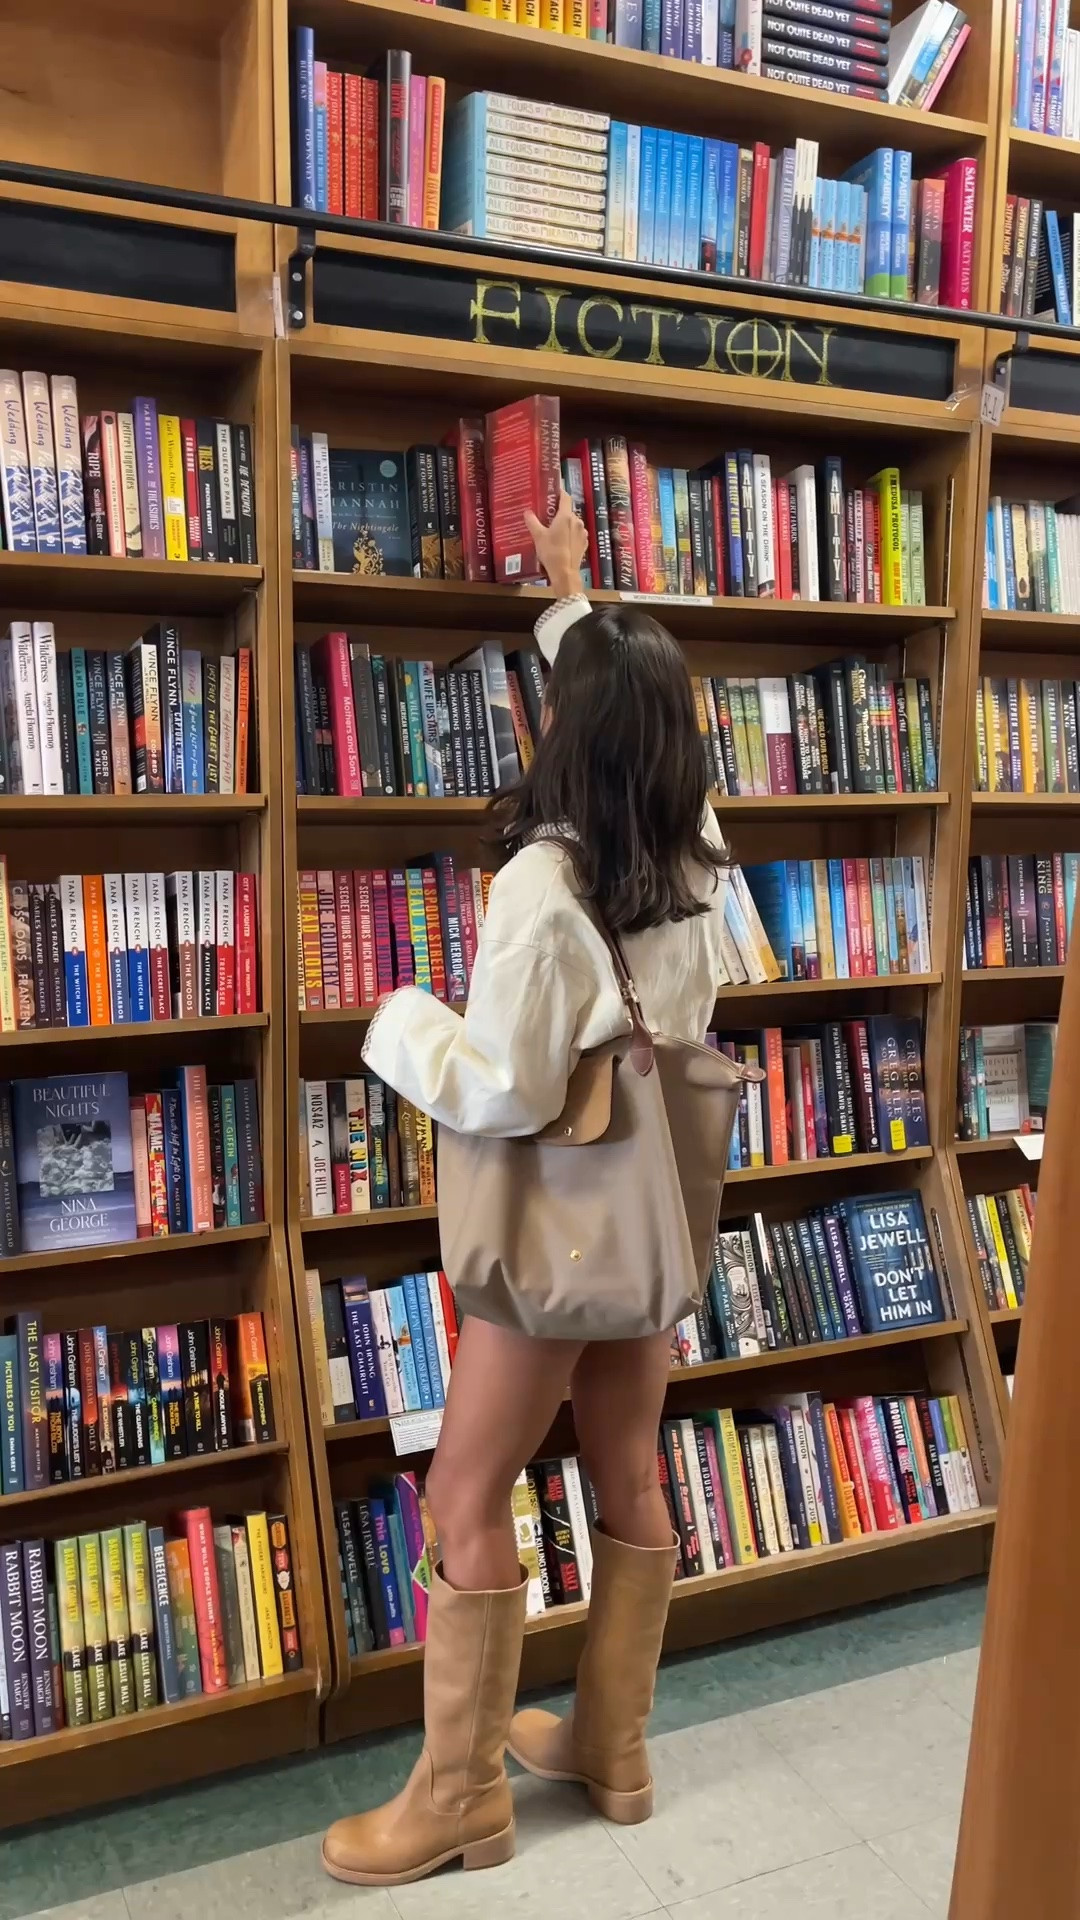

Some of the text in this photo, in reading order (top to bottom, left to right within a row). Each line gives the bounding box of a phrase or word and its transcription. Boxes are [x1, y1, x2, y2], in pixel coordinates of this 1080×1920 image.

[767, 20, 850, 48] NOT QUITE DEAD YET
[767, 69, 850, 94] NOT QUITE DEAD YET
[881, 152, 892, 219] CULPABILITY
[897, 154, 909, 220] CULPABILITY
[961, 166, 976, 293] SALTWATER KATY HAYS
[1032, 203, 1040, 236] STEPHEN
[469, 279, 838, 386] FICTION
[5, 400, 20, 444] Wedding
[33, 401, 49, 446] Wedding
[62, 404, 76, 448] Wedding
[143, 403, 152, 440] HARRIET
[982, 392, 997, 421] K-L
[88, 452, 100, 477] RIPE
[466, 440, 477, 486] HANNAH
[550, 423, 560, 470] KRISTIN
[591, 451, 601, 491] HARKAWAY
[333, 521, 399, 532] The Nightingale
[475, 507, 488, 555] WOMEN
[743, 463, 753, 577] AMITY
[830, 470, 841, 581] AMITY
[618, 543, 631, 586] HARKIN
[40, 634, 51, 682] Wilderness
[166, 629, 177, 706] VINCE FLYNN
[94, 656, 104, 725] VINCE FLYNN
[150, 683, 158, 721] FLYNN
[531, 667, 542, 697] QUEEN
[343, 697, 352, 726] Mothers
[348, 751, 356, 776] Sons
[429, 705, 437, 743] UPSTAIRS
[301, 893, 322, 987] DEAD LIONS
[318, 889, 339, 986] JOE COUNTRY
[339, 886, 354, 993] SECRET HOURS MICK HERRON
[424, 889, 445, 979] SPOOK STREET
[447, 917, 464, 976] MICK HERRON
[18, 973, 31, 1026] FRANZEN
[33, 1083, 111, 1103] BEAUTIFUL
[907, 1039, 922, 1123] GREG ILES
[46, 1102, 99, 1118] NIGHTS
[225, 1098, 234, 1157] EMILY GIFFIN
[311, 1094, 326, 1197] NOS4A2 JOE HILL
[348, 1107, 368, 1183] THE NIX
[50, 1213, 109, 1232] GEORGE
[61, 1198, 97, 1213] NINA
[869, 1211, 909, 1228] LISA
[743, 1240, 754, 1273] REUNION
[777, 1246, 787, 1268] JEWELL
[831, 1227, 846, 1283] LISA JEWELL
[860, 1230, 926, 1250] JEWELL
[714, 1244, 724, 1284] TWILIGHT
[875, 1265, 925, 1287] DON'T
[880, 1301, 932, 1321] HIM IN
[889, 1286, 916, 1301] LET
[354, 1328, 362, 1347] LAST
[5, 1361, 13, 1396] PICTURES
[27, 1320, 41, 1424] THE LAST VISITOR
[98, 1350, 106, 1381] Grisham
[357, 1351, 368, 1395] CHAIRLIFT
[364, 1348, 375, 1378] IRVING
[7, 1411, 15, 1432] YOU
[864, 1401, 886, 1480] SUMMERHOUSE
[341, 1510, 356, 1582] LISA JEWELL
[375, 1515, 389, 1574] This Love
[154, 1546, 168, 1606] BENEFICENCE
[6, 1550, 25, 1663] RABBIT MOON
[29, 1548, 48, 1660] RABBIT MOON
